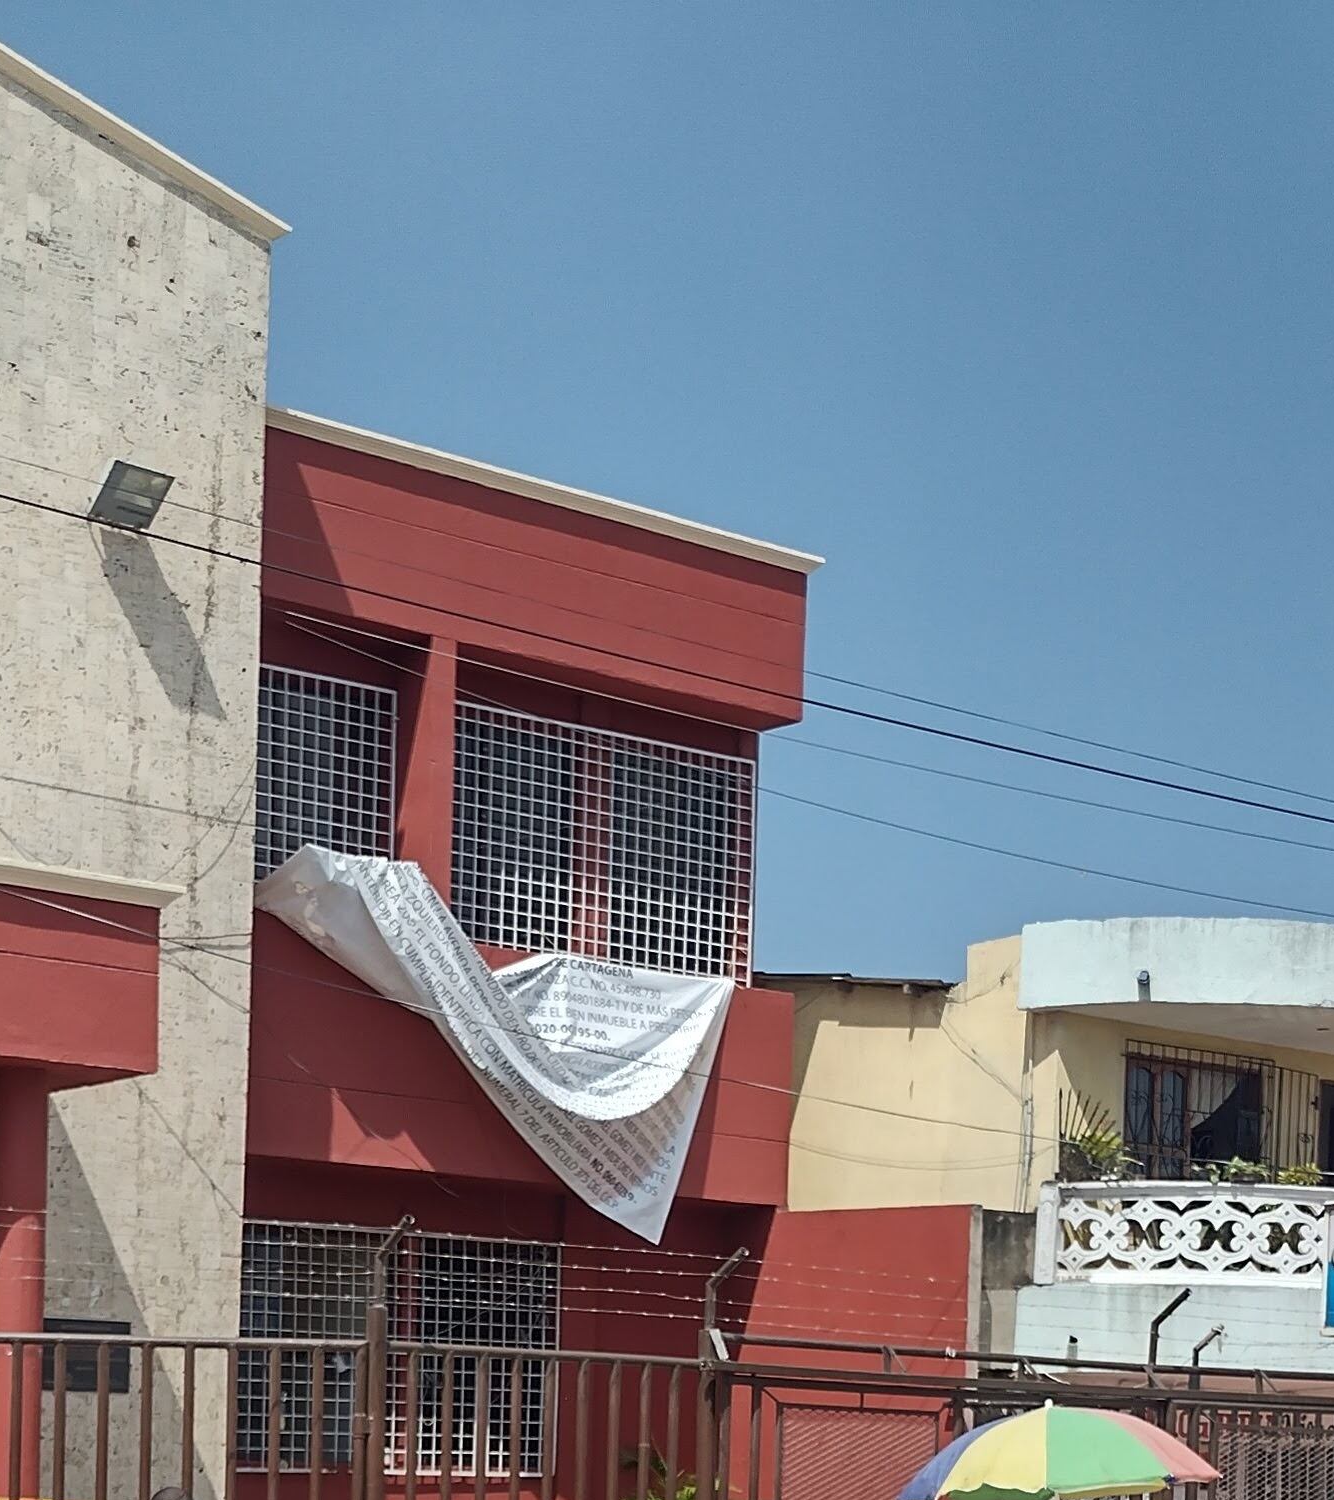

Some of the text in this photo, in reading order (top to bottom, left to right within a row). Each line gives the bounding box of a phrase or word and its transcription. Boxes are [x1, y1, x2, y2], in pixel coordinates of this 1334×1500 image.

[570, 959, 634, 979] CARTAGENA
[433, 979, 483, 1038] IDENTIFICA
[480, 1037, 501, 1063] CON
[549, 1007, 563, 1019] EL
[588, 1012, 637, 1029] INMUEBLE
[639, 1020, 647, 1031] A
[481, 1065, 522, 1112] NUMERAL
[524, 1115, 543, 1135] DEL
